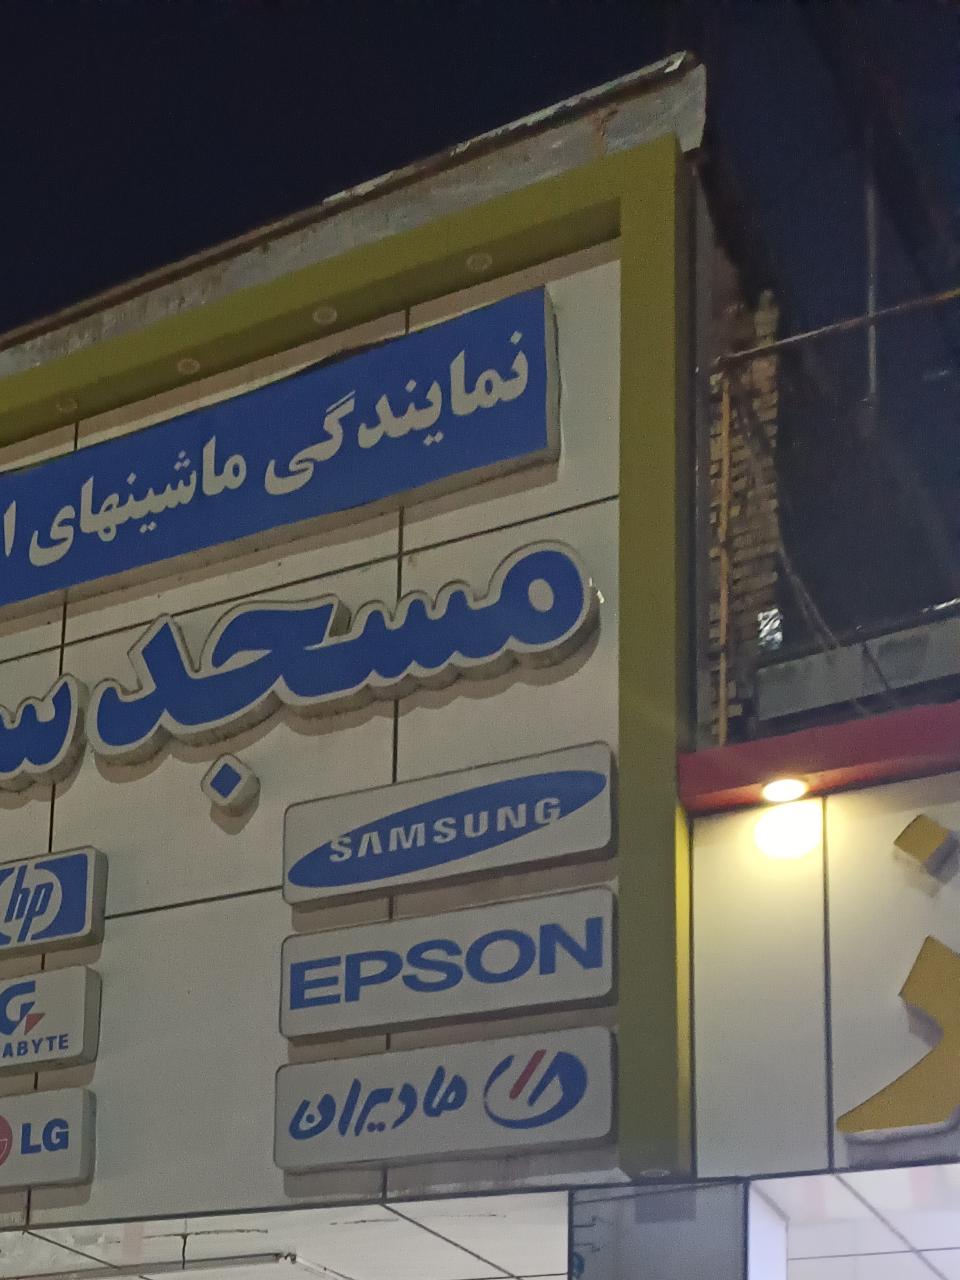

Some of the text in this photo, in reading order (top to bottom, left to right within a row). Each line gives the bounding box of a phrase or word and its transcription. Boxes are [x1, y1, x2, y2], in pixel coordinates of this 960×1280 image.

[264, 331, 530, 497] نمایندگی
[329, 796, 562, 862] SAMSUNG
[4, 863, 53, 943] hp
[288, 916, 603, 1011] EPSON
[20, 1118, 70, 1156] LG
[288, 1065, 470, 1142] مادیران
